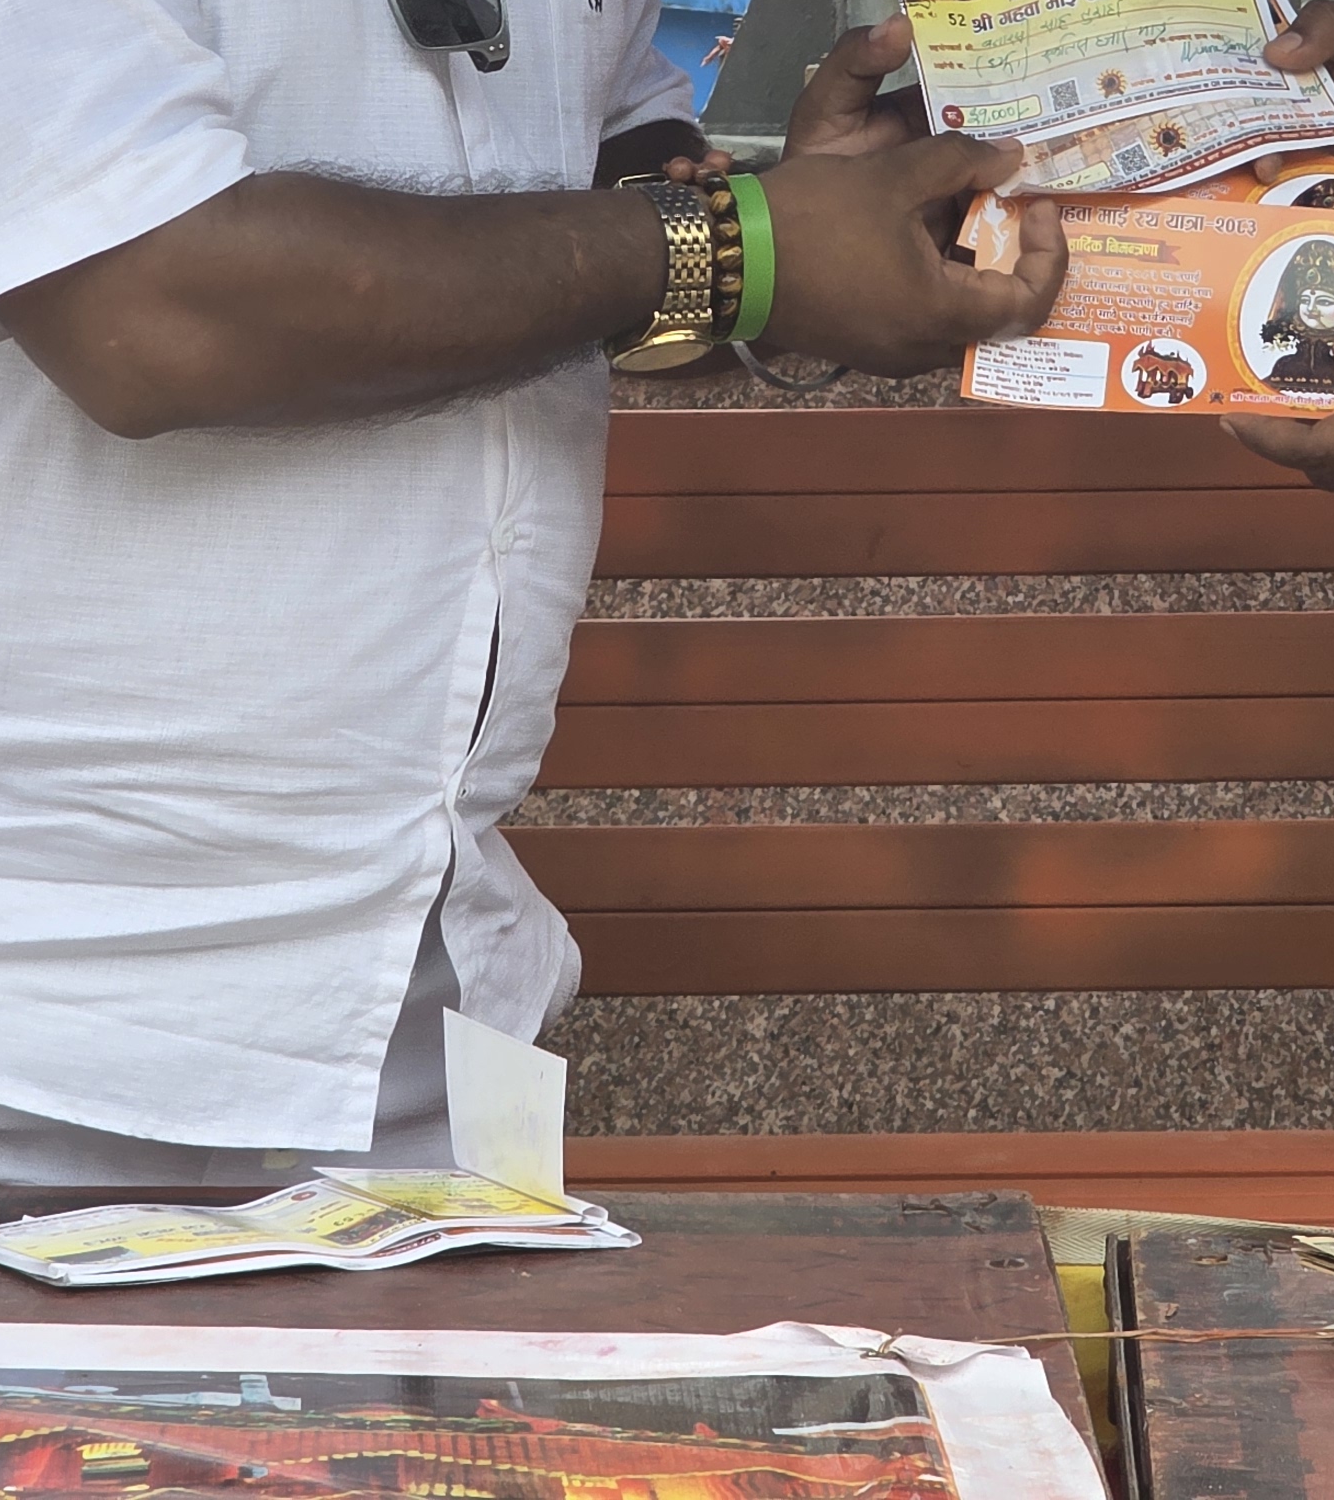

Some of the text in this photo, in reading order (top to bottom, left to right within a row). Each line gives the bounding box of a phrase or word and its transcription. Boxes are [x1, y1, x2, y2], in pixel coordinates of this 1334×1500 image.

[947, 12, 968, 28] 52
[971, 13, 995, 35] श्री
[998, 0, 1040, 26] गहवा
[1098, 203, 1130, 229] माई
[1134, 209, 1162, 229] रथ
[1165, 212, 1259, 238] यात्रा-२०८३
